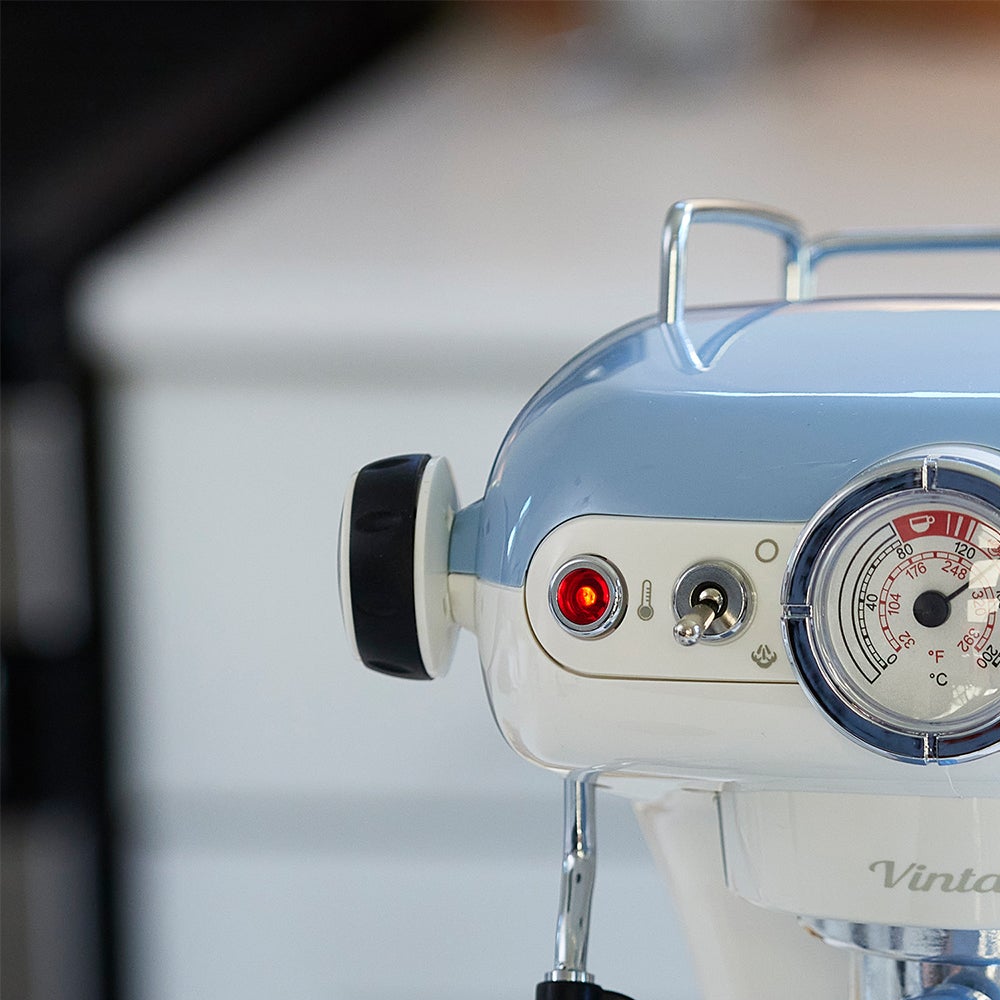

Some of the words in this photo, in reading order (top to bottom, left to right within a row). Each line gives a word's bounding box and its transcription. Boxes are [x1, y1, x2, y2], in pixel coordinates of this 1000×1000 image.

[896, 543, 914, 560] 80
[953, 541, 976, 560] 120
[905, 561, 927, 581] 176
[941, 560, 967, 581] 248
[867, 593, 879, 612] 40
[887, 592, 901, 617] 104
[972, 590, 986, 617] 320
[898, 630, 916, 650] 32
[957, 627, 980, 653] 392
[887, 653, 898, 665] 0
[928, 650, 944, 663] °F
[976, 645, 1000, 669] 200
[929, 673, 948, 686] °C
